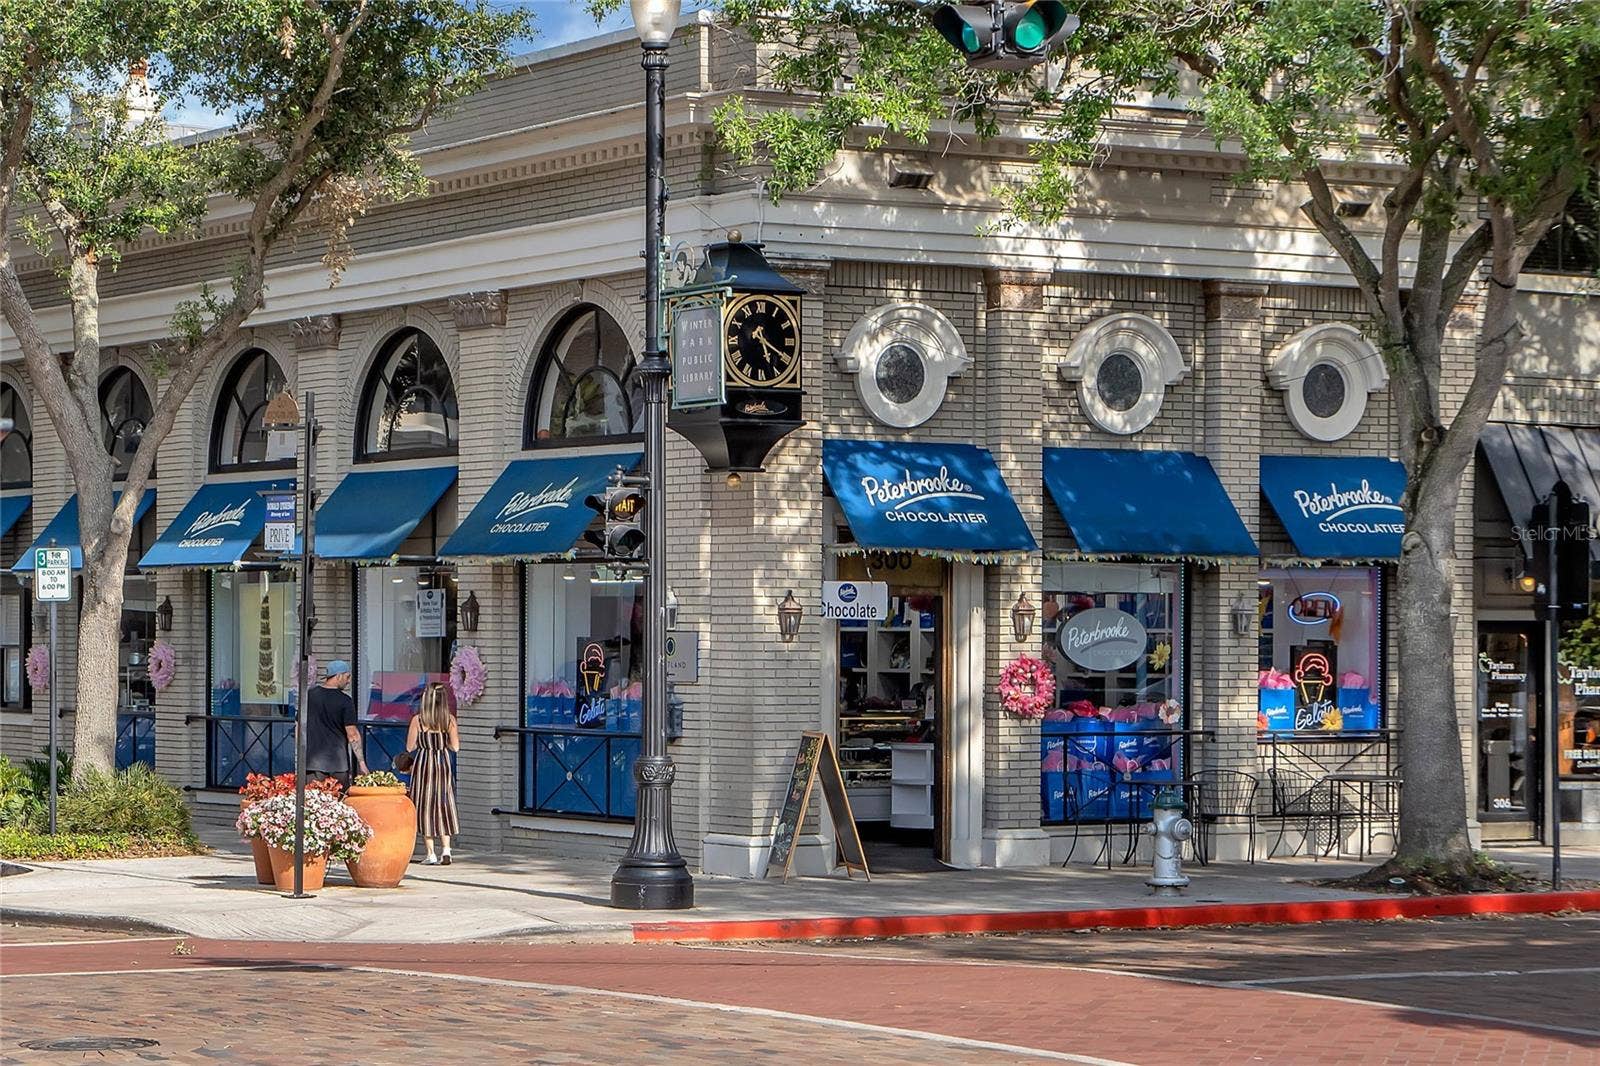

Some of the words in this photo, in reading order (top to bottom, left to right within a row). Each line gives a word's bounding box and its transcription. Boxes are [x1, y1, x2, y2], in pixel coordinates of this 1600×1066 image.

[681, 319, 712, 331] WINTER
[682, 337, 712, 349] PARK
[682, 356, 713, 366] PUBLIC
[682, 371, 713, 384] LIBRARY
[615, 499, 635, 513] WAIT
[885, 510, 988, 524] CHOCOLATIER
[490, 521, 550, 534] CHOCOLATIER
[38, 551, 46, 566] 3
[820, 600, 877, 618] Chocolate
[1294, 598, 1335, 618] OPEN
[1068, 616, 1130, 651] Peterbrooke
[580, 697, 606, 725] Gelato
[1295, 699, 1334, 731] Gelato
[1493, 798, 1512, 809] 306
